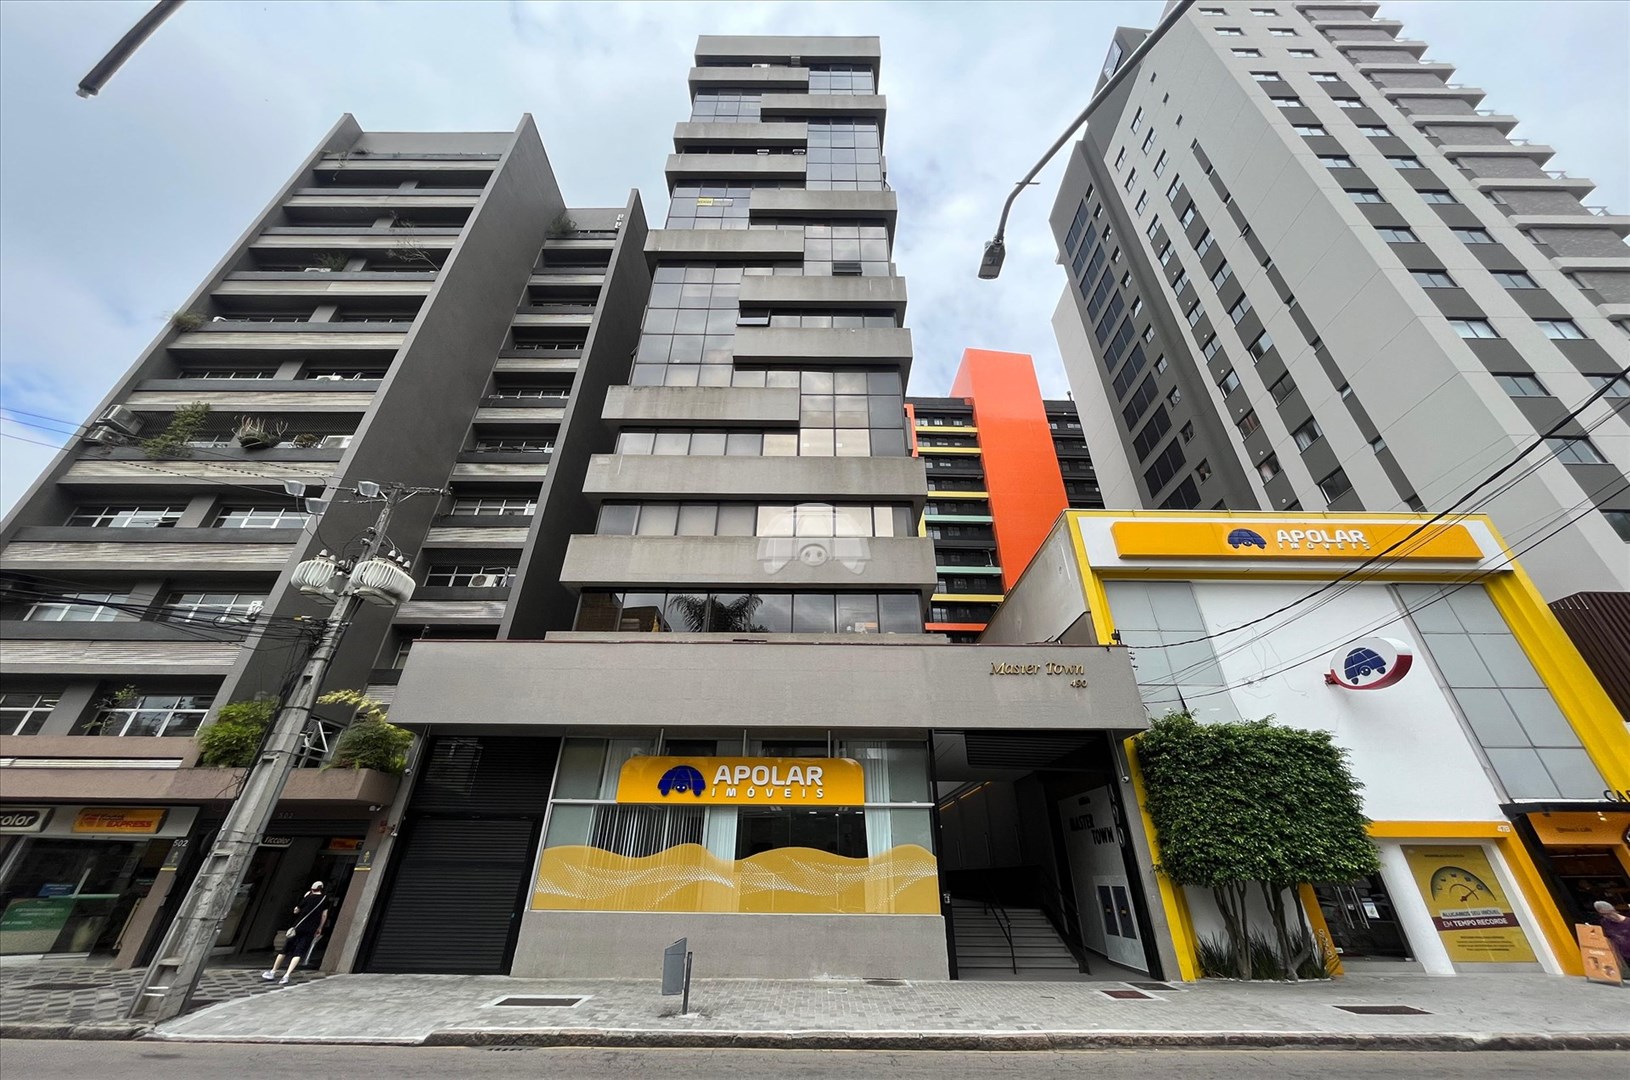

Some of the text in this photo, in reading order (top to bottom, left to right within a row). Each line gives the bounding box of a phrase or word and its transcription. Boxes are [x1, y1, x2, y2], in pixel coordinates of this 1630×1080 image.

[1277, 529, 1368, 543] APOLAR
[990, 662, 1084, 675] Master Town
[1070, 680, 1088, 688] 490
[713, 765, 823, 786] APOLAR
[711, 786, 824, 798] IMÓVEIS
[0, 813, 35, 826] olor
[106, 820, 153, 828] EXPRESS
[1091, 827, 1115, 845] TOWN
[173, 839, 189, 847] 502
[1454, 919, 1476, 927] TEMPO
[1477, 917, 1508, 926] RECORDE
